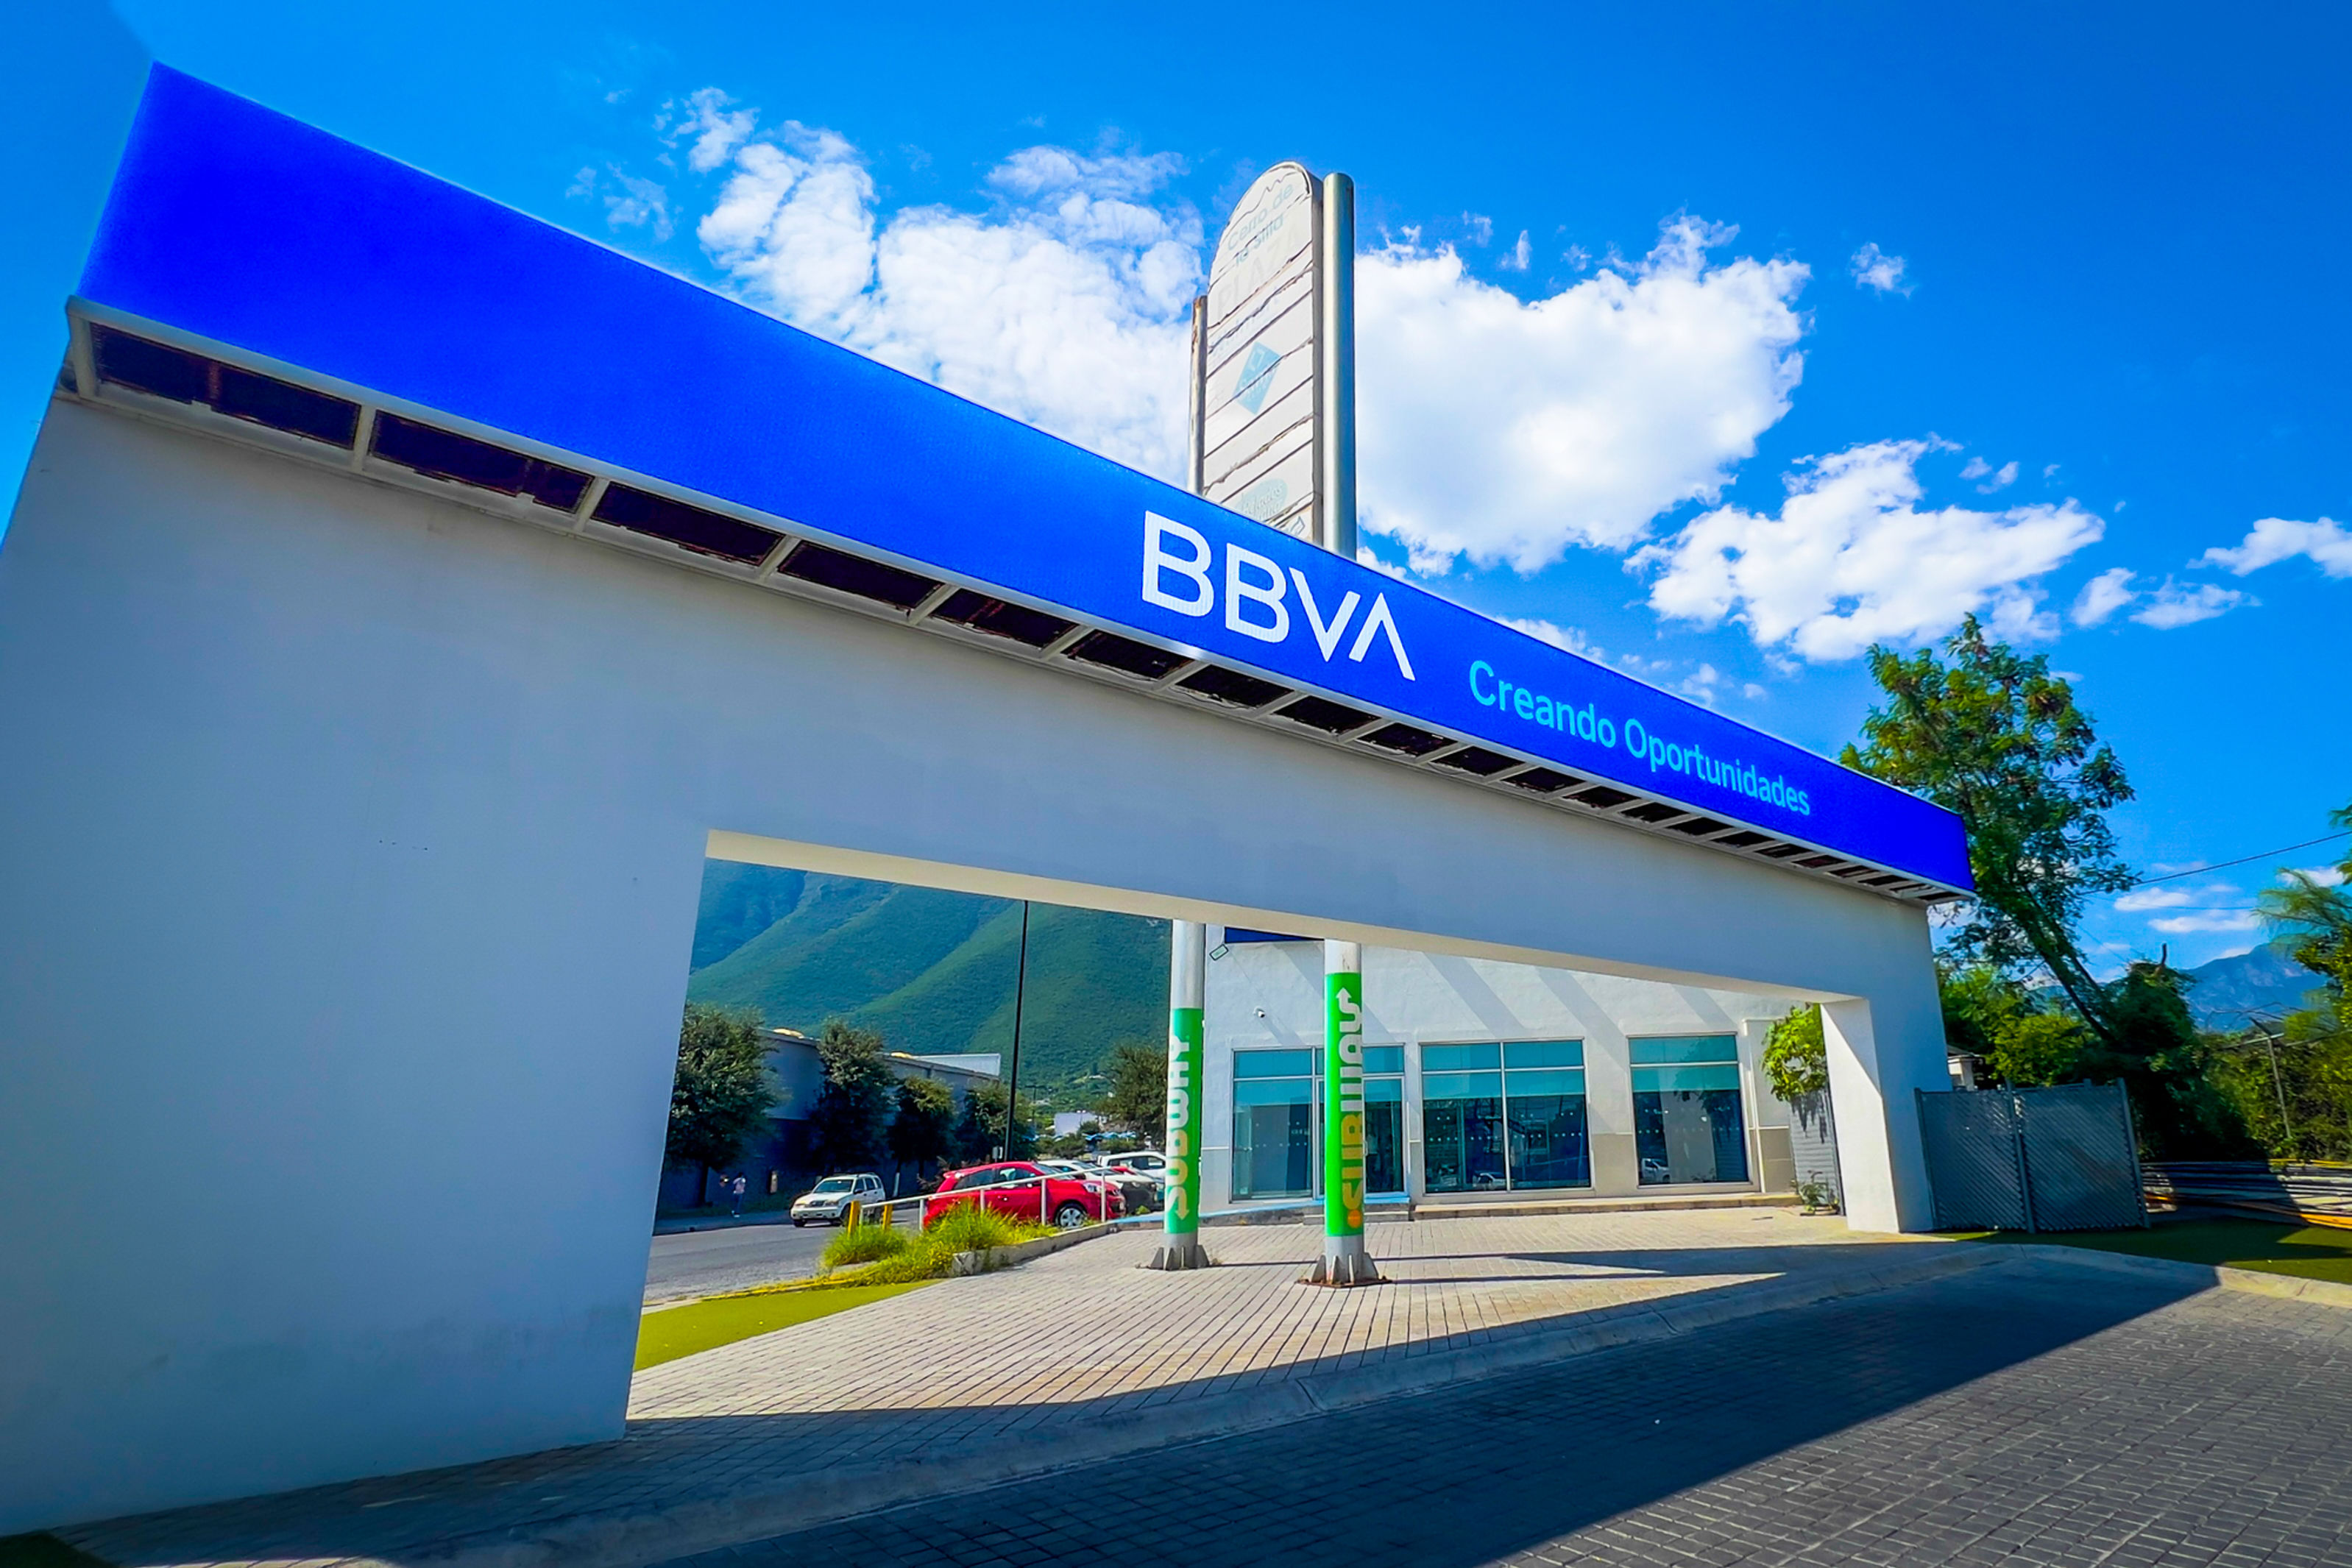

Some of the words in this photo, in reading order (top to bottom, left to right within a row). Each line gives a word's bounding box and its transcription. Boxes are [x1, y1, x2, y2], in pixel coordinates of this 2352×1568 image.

[1227, 207, 1268, 251] Cerro
[1272, 183, 1294, 209] de
[1142, 511, 1415, 681] BBVA
[1470, 661, 1616, 748] Creando
[1625, 719, 1810, 815] Oportunidades
[1166, 1035, 1191, 1221] SUBWAY
